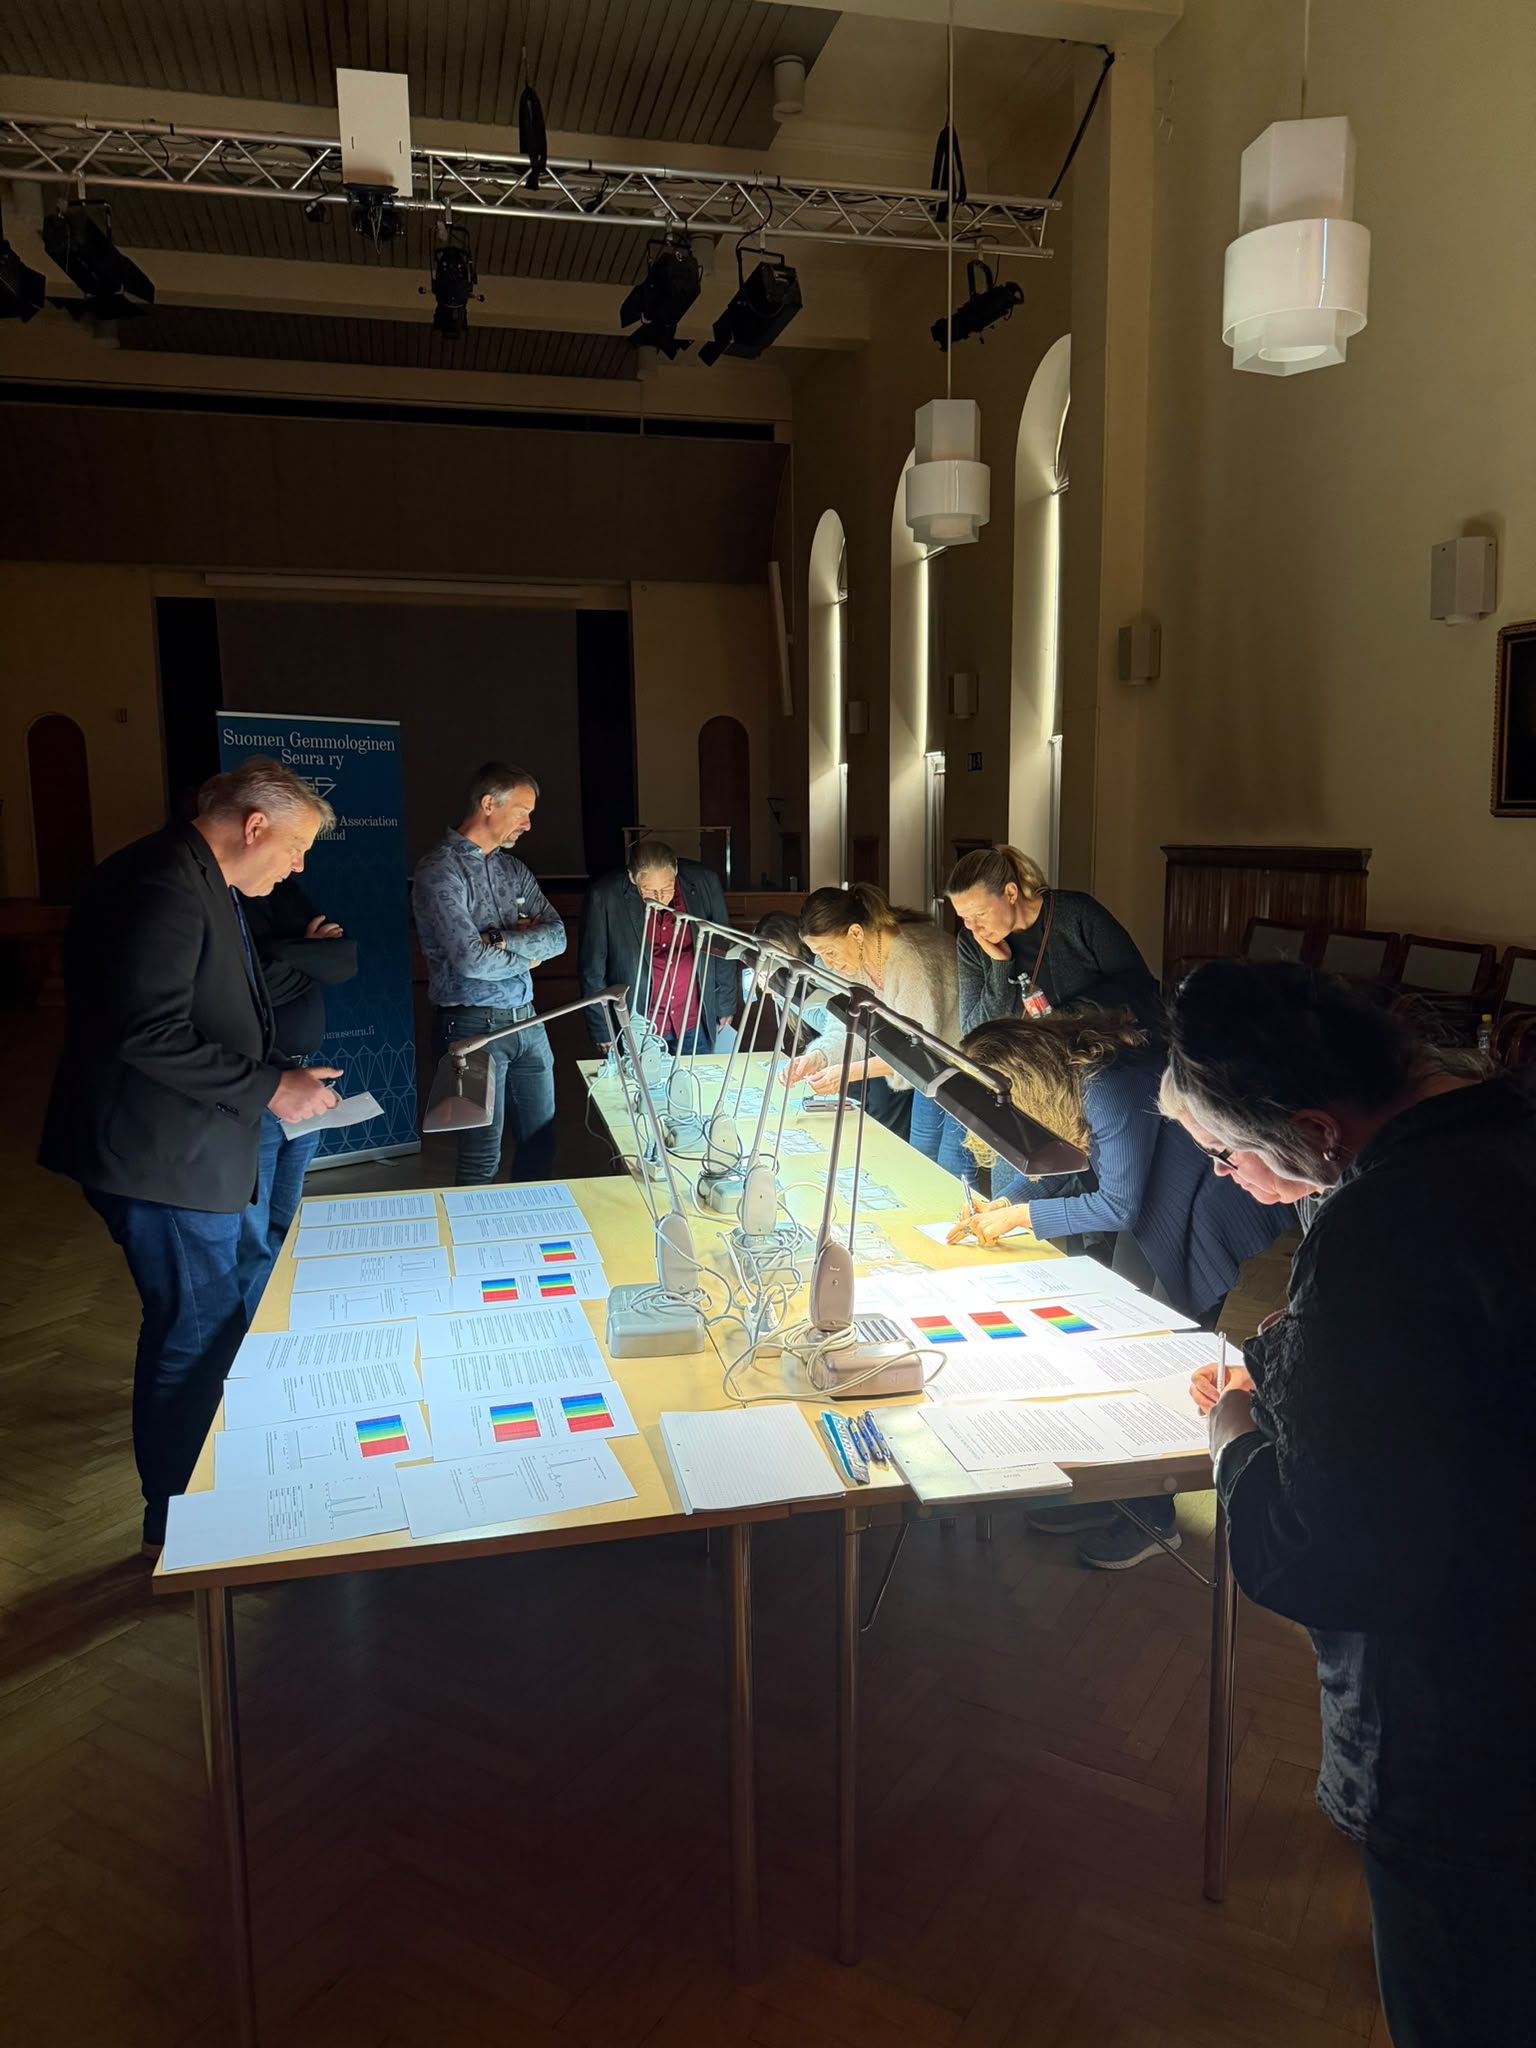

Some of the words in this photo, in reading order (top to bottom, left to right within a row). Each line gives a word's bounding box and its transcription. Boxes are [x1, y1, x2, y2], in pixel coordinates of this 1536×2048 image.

[223, 728, 285, 747] Suomen
[289, 731, 396, 754] Gemmologinen
[281, 748, 325, 765] Seura
[328, 754, 345, 771] ry
[339, 815, 398, 827] Association
[314, 829, 346, 841] nland
[323, 1025, 375, 1040] mmoseura.fi
